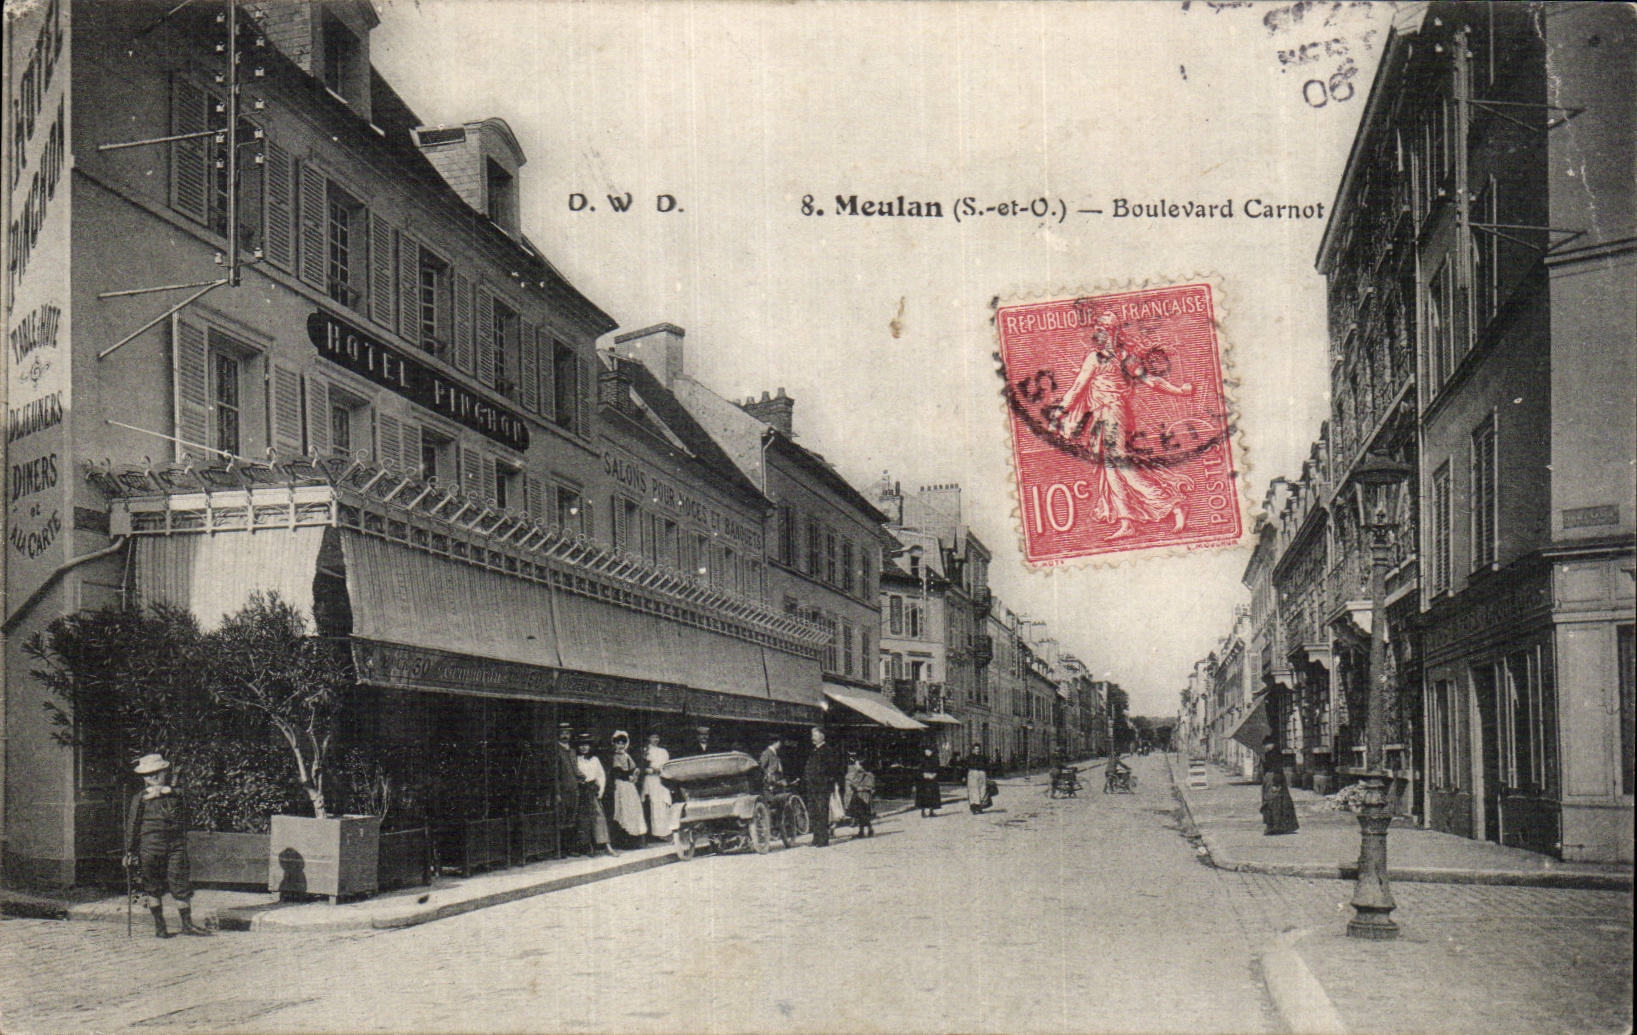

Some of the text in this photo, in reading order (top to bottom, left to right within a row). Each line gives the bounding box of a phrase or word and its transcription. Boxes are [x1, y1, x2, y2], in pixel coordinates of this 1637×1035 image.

[328, 321, 522, 442] HOTEL PINCHON
[604, 451, 647, 493] SALONS
[652, 478, 675, 507] POUR
